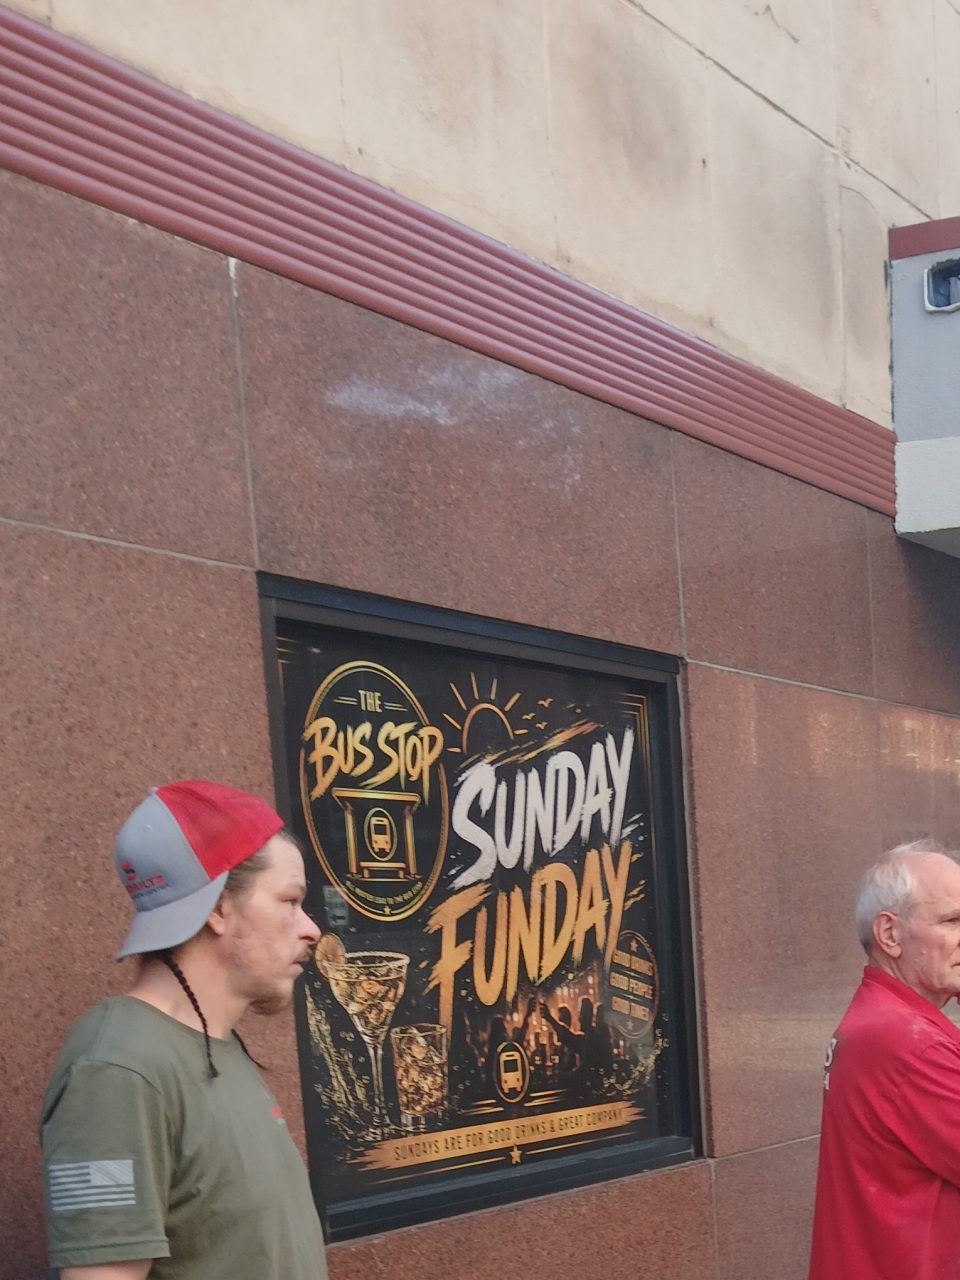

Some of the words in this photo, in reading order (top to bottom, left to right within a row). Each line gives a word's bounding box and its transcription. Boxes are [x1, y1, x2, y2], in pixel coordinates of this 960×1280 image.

[358, 689, 383, 713] THE
[303, 716, 375, 801] BUS
[359, 721, 444, 808] STOP
[448, 725, 635, 891] SUNDAY
[423, 839, 633, 1045] FUNDAY
[393, 1138, 439, 1162] SUNDAYS
[443, 1135, 462, 1152] ARE
[464, 1132, 485, 1148] FOR
[515, 1120, 547, 1139] DRINKS
[549, 1119, 556, 1133] &
[558, 1114, 584, 1131] GREAT
[586, 1108, 623, 1127] COMPANY
